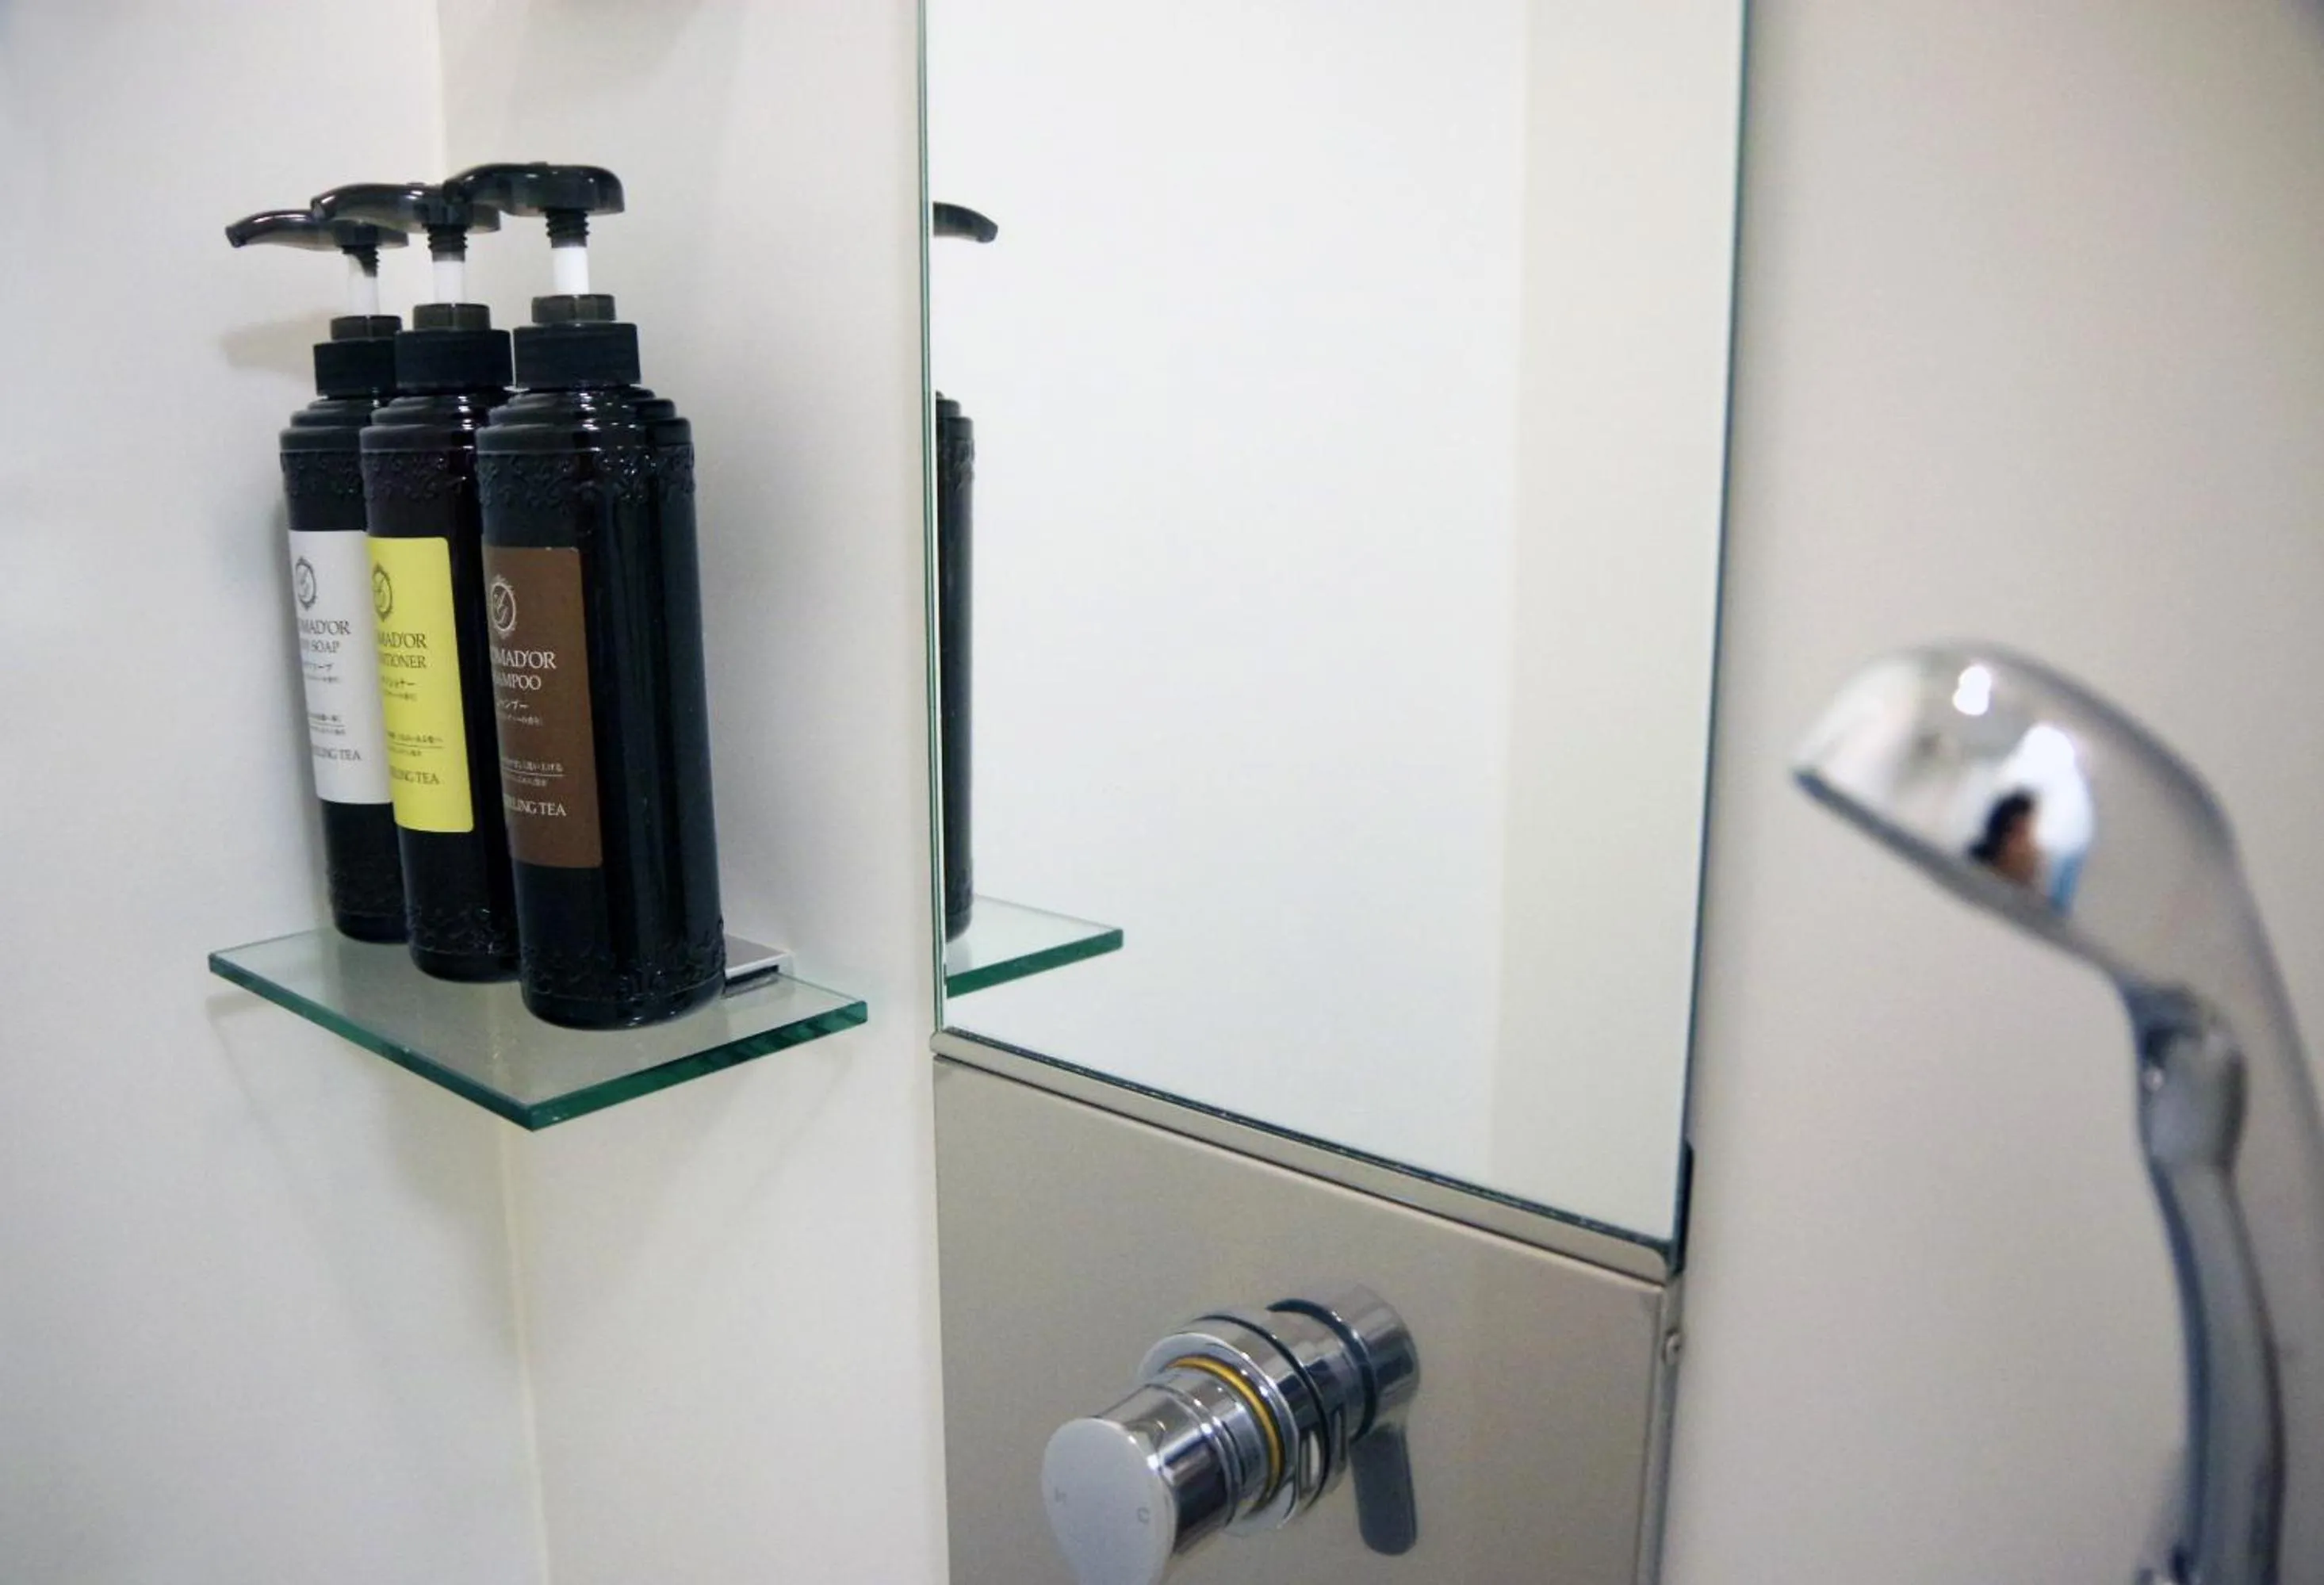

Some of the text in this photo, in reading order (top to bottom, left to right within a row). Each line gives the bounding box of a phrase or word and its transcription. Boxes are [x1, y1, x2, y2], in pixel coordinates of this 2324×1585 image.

[312, 639, 339, 653] SOAP
[338, 748, 362, 761] TEA
[415, 771, 440, 786] TEA
[540, 802, 567, 817] TEA
